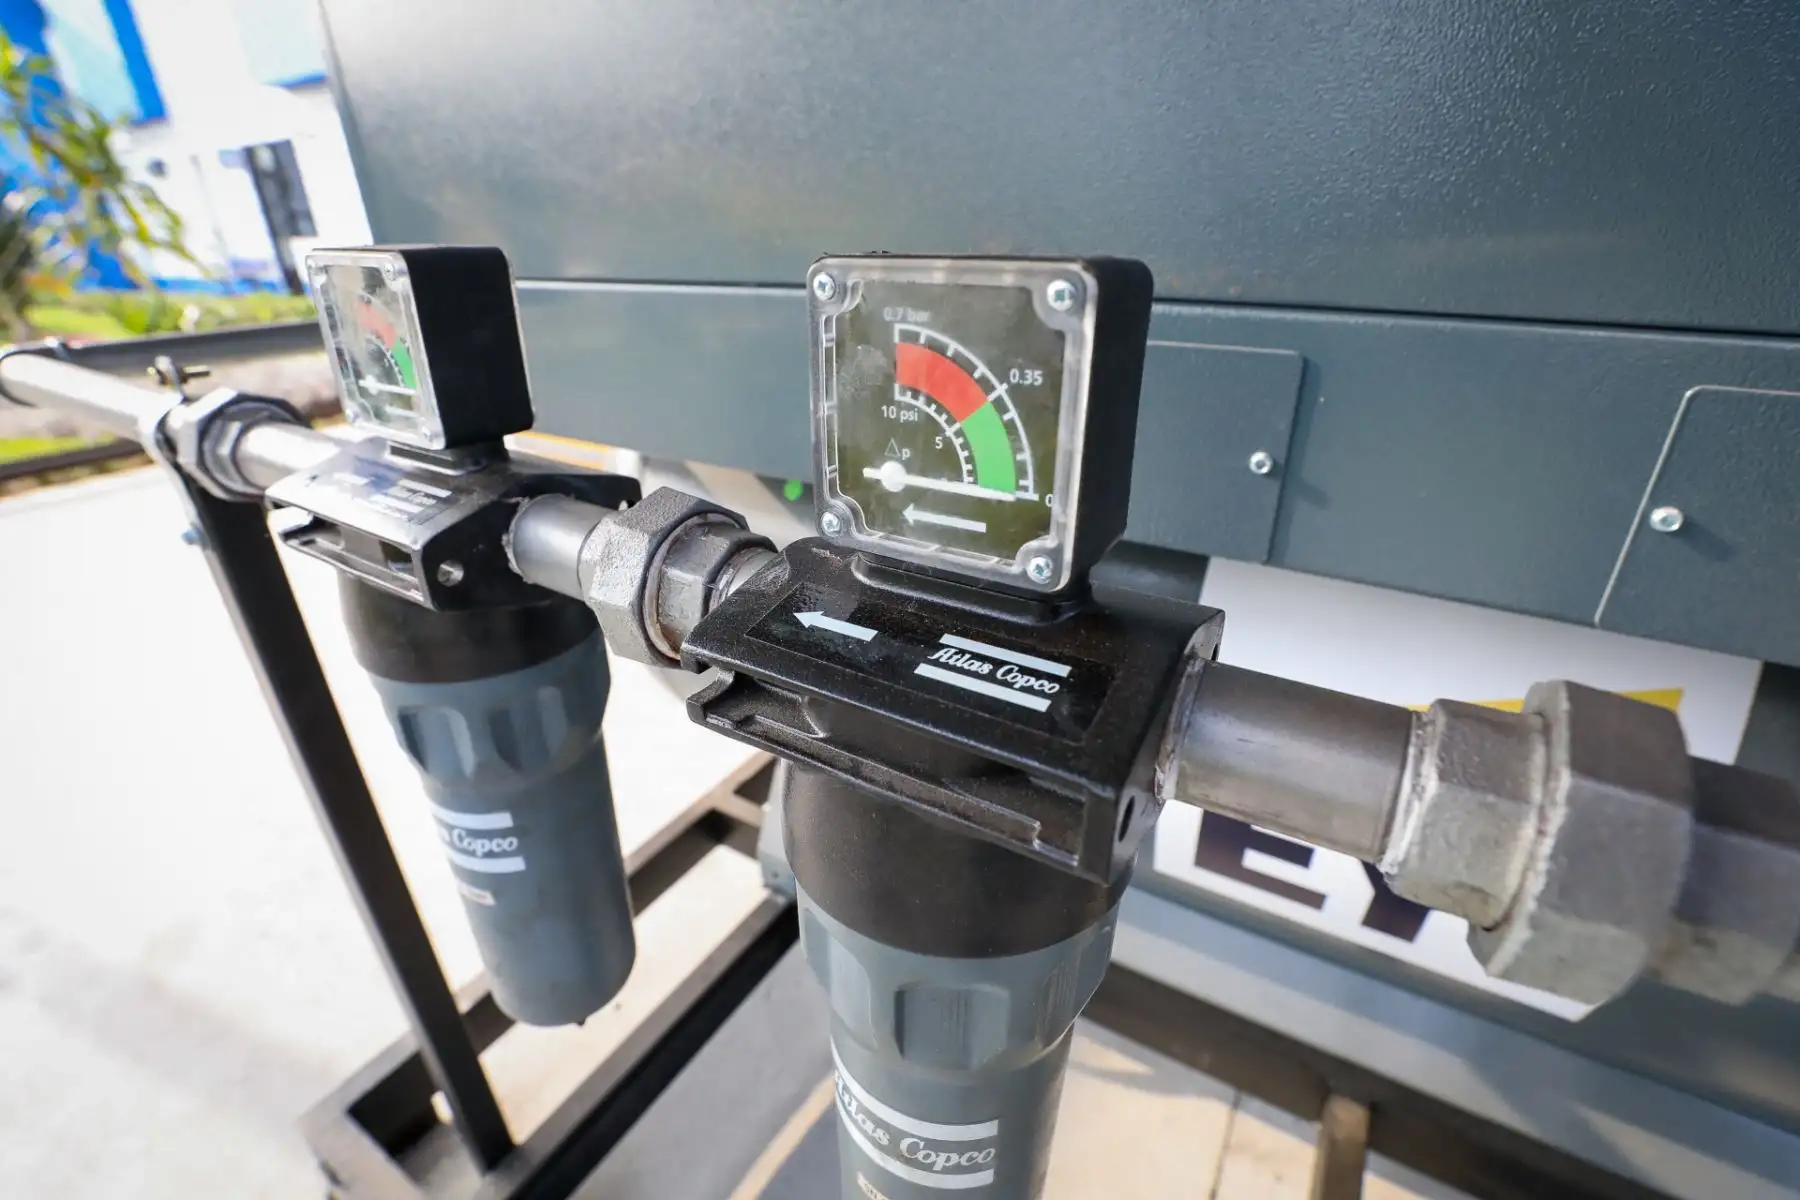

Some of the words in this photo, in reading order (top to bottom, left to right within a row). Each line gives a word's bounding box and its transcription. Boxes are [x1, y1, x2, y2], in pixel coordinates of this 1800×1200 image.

[883, 306, 904, 321] 0.7
[907, 307, 931, 322] bar
[1009, 367, 1043, 386] 0.35
[881, 404, 897, 419] 10
[900, 407, 918, 424] psi
[935, 436, 944, 450] 5
[927, 647, 994, 675] Atlas
[996, 664, 1060, 694] Copco
[452, 828, 519, 857] Copco
[900, 1137, 996, 1171] Copco
